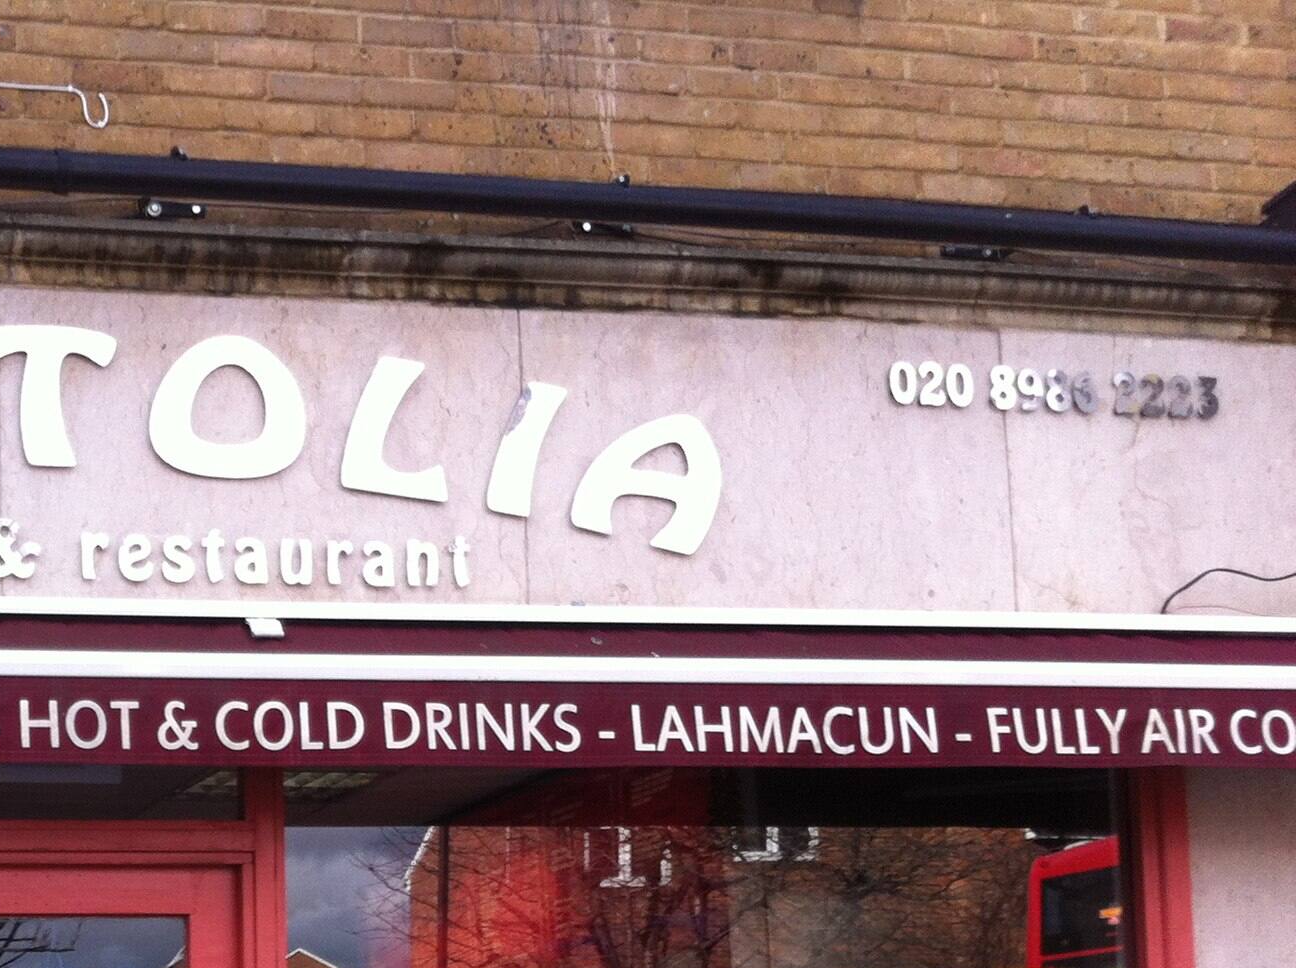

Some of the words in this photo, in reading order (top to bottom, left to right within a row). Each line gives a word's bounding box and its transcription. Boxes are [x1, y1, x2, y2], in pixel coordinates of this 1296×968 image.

[889, 361, 974, 407] 020
[990, 365, 1099, 414] 8986
[1112, 372, 1220, 420] 2223
[80, 529, 471, 588] restaurant
[19, 699, 139, 750] HOT
[157, 700, 199, 751] &
[215, 700, 365, 751] COLD
[383, 702, 581, 752] DRINKS
[631, 704, 938, 755] LAHMACUN
[986, 707, 1128, 755] FULLY
[1141, 708, 1220, 755] AIR
[1230, 709, 1296, 756] CO
